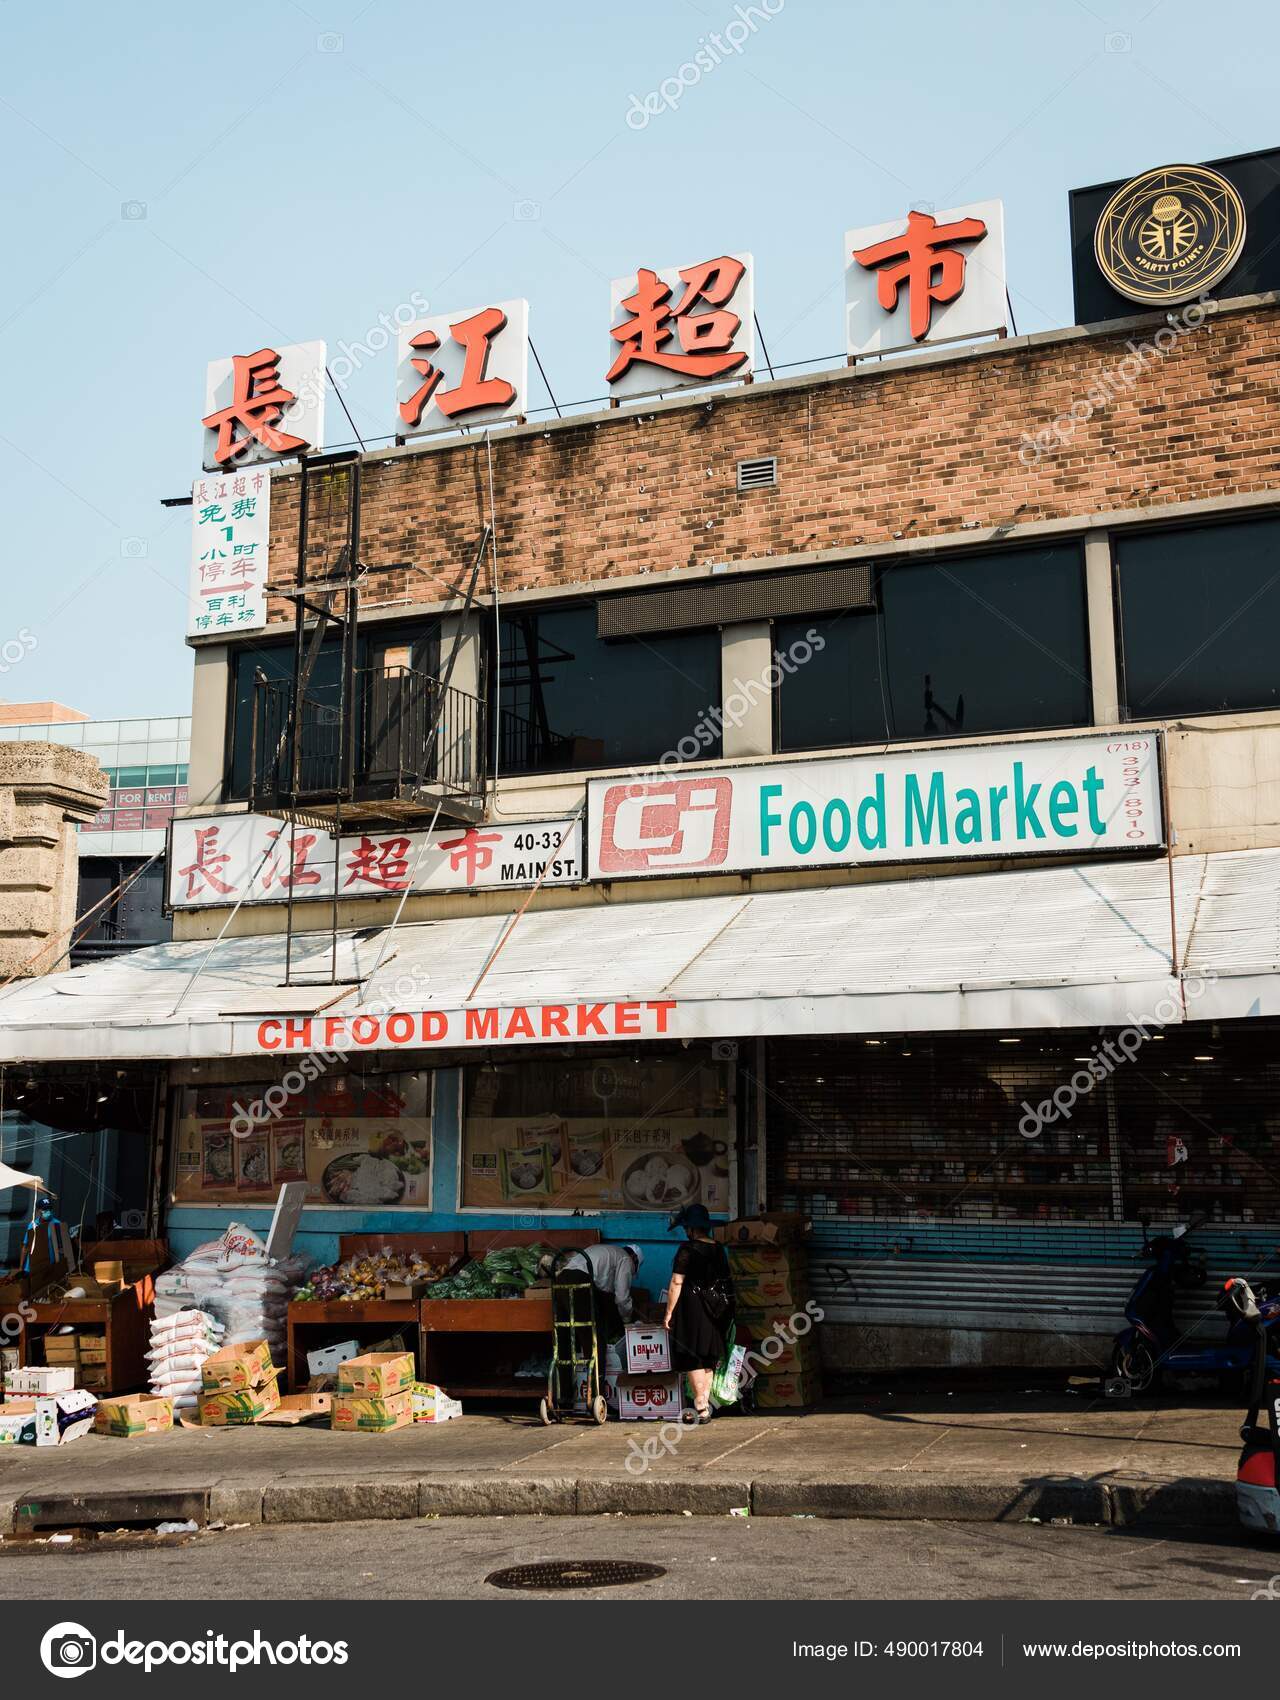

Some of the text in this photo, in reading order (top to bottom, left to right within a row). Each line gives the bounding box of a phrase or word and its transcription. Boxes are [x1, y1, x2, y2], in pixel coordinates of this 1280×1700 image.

[1138, 249, 1202, 272] PARTY POINT
[202, 209, 989, 466] 長江超市
[196, 472, 265, 504] 長江超市
[198, 497, 257, 525] 免费
[220, 525, 234, 542] 1
[200, 543, 258, 561] 小时
[198, 557, 257, 583] 停车
[206, 594, 246, 611] 百利
[196, 609, 256, 630] 停车场
[1106, 741, 1149, 754] (718)
[119, 792, 172, 803] FOR RENT
[759, 773, 887, 857] Food
[904, 761, 1107, 848] Market
[513, 830, 562, 852] 40-33
[178, 825, 504, 899] 長江超市
[500, 858, 579, 882] MAIN ST.
[257, 999, 677, 1050] CH FOOD MARKET
[636, 1343, 660, 1355] BALLY
